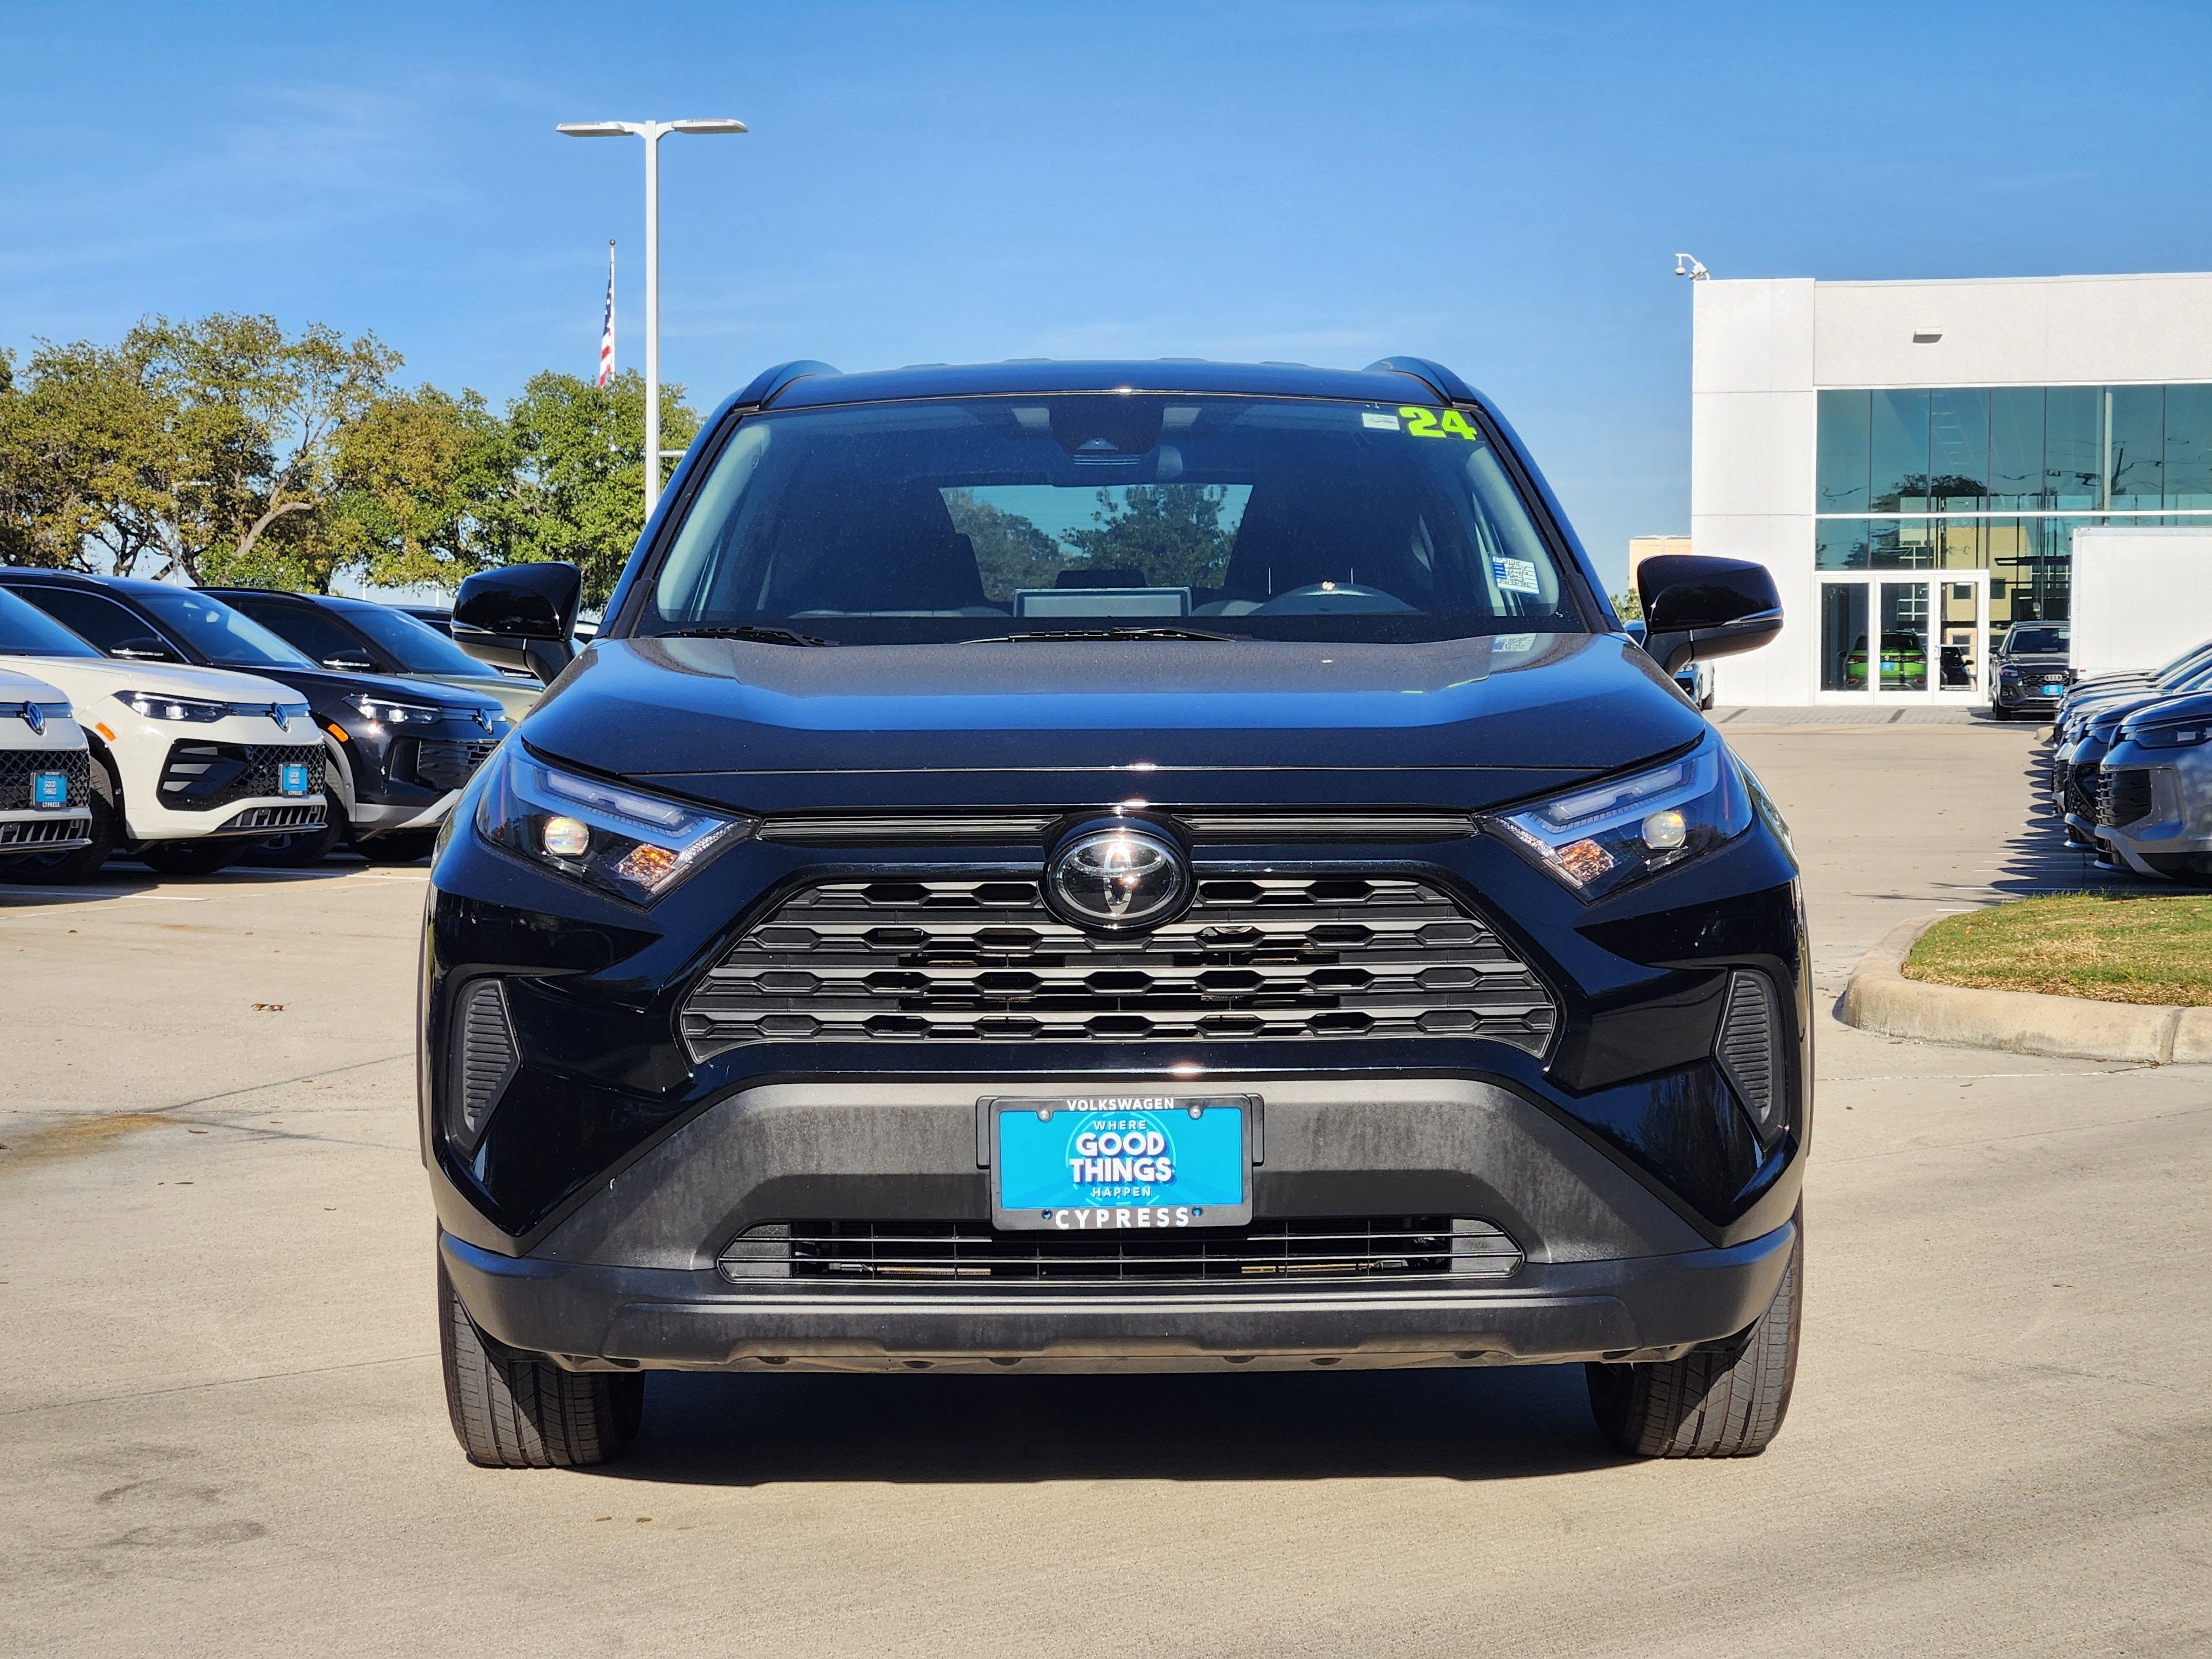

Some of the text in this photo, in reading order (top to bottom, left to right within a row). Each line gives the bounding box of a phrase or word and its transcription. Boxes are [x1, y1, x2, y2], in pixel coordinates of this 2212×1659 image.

[1399, 406, 1477, 440] 24
[1067, 1097, 1175, 1112] VOLKSWAGEN
[1093, 1120, 1147, 1130] WHERE
[1076, 1131, 1165, 1156] GOOD
[1069, 1157, 1172, 1183] THINGS
[1093, 1187, 1151, 1197] HAPPEN
[1055, 1207, 1189, 1229] CYPRESS
